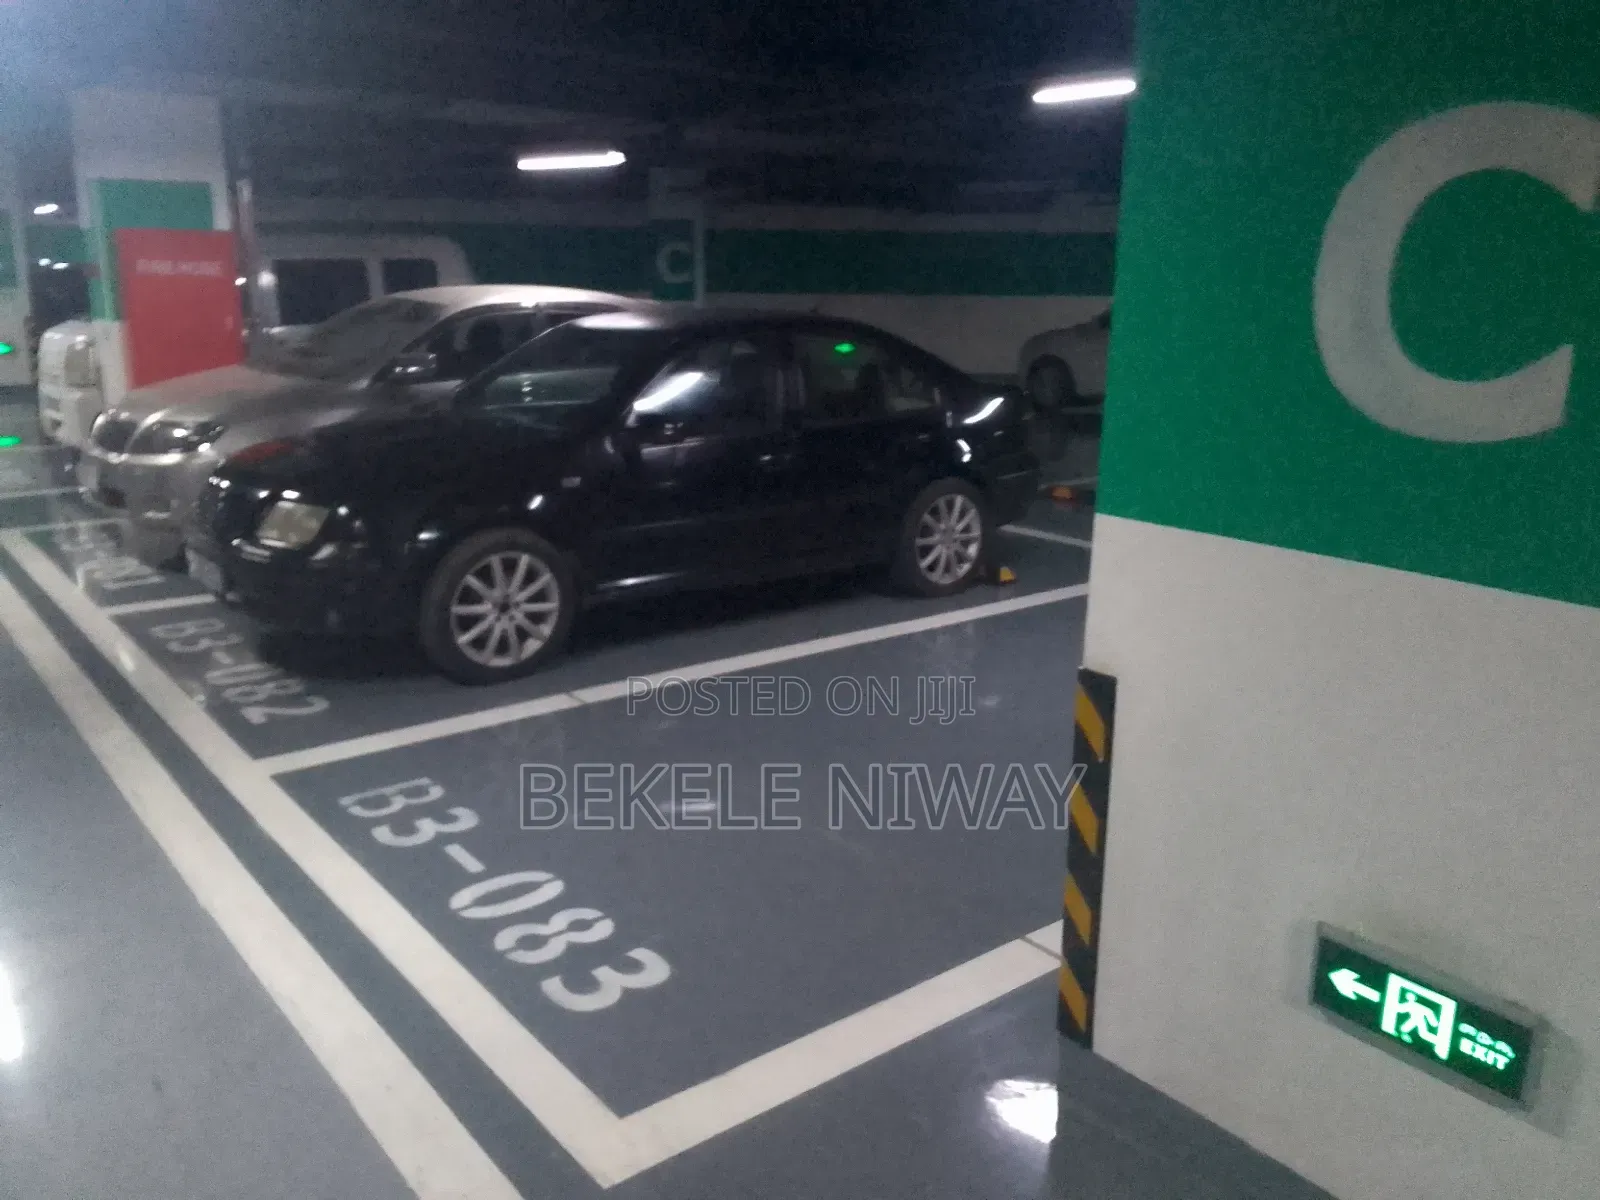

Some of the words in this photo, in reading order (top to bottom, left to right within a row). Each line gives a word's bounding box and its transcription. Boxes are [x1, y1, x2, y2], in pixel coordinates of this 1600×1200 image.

[656, 241, 694, 284] C
[1312, 101, 1600, 442] C
[150, 617, 330, 725] B3-082
[338, 777, 672, 1012] B3-083
[1459, 1037, 1510, 1070] EXIT
